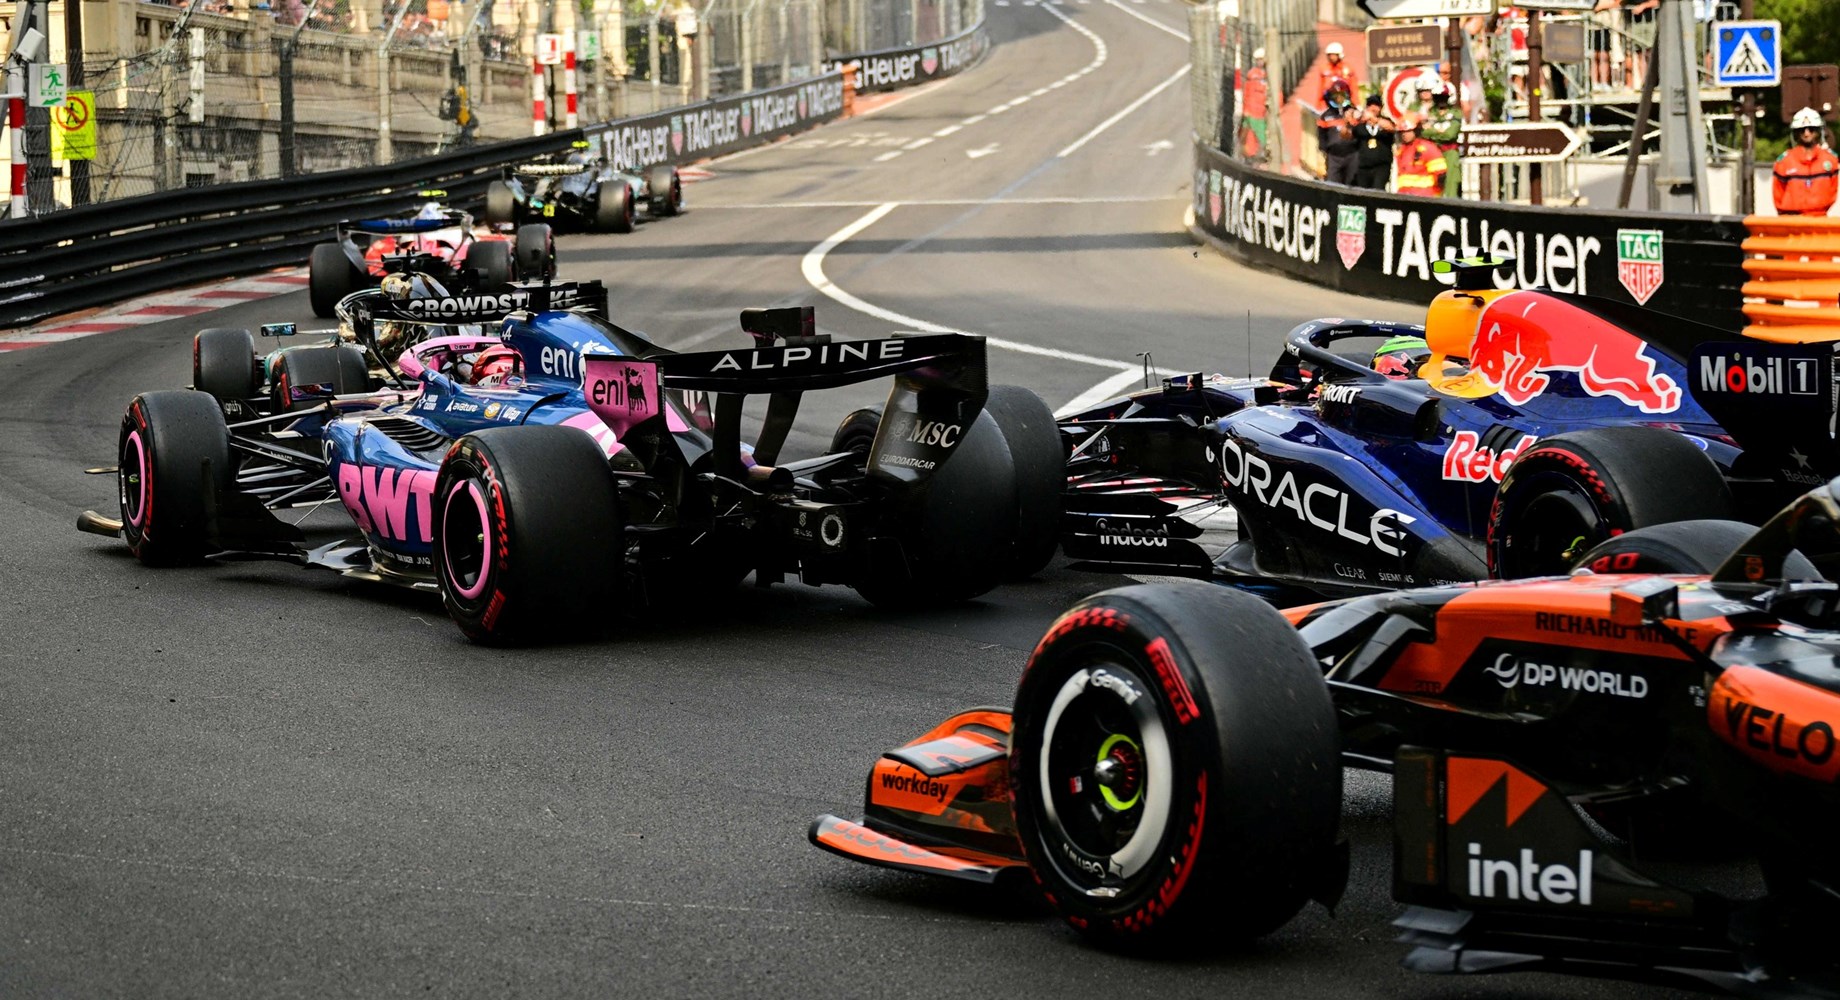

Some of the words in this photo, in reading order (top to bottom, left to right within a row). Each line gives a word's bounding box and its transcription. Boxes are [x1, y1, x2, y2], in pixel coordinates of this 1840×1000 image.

[1377, 45, 1432, 58] D'OSTENDE
[1385, 33, 1423, 45] AVENUE
[1339, 209, 1364, 230] TAG
[1620, 235, 1660, 260] TAG
[1619, 266, 1662, 299] HEUER
[541, 346, 575, 378] eni
[711, 339, 905, 372] ALPINE
[592, 371, 624, 406] eni
[1700, 355, 1783, 394] Mobil
[1796, 361, 1807, 392] 1
[906, 419, 961, 448] MSC
[880, 454, 935, 470] EURODATACAR
[339, 462, 439, 542] BWT
[1222, 438, 1417, 557] ORACLE
[1334, 563, 1366, 580] CLEAR
[1378, 571, 1414, 583] SIEMNS
[1536, 611, 1627, 639] RICHARD
[1523, 662, 1557, 686] DP
[1560, 666, 1649, 698] WORLD
[1725, 697, 1836, 764] VELO
[882, 773, 949, 803] workday
[1468, 842, 1592, 905] intel
